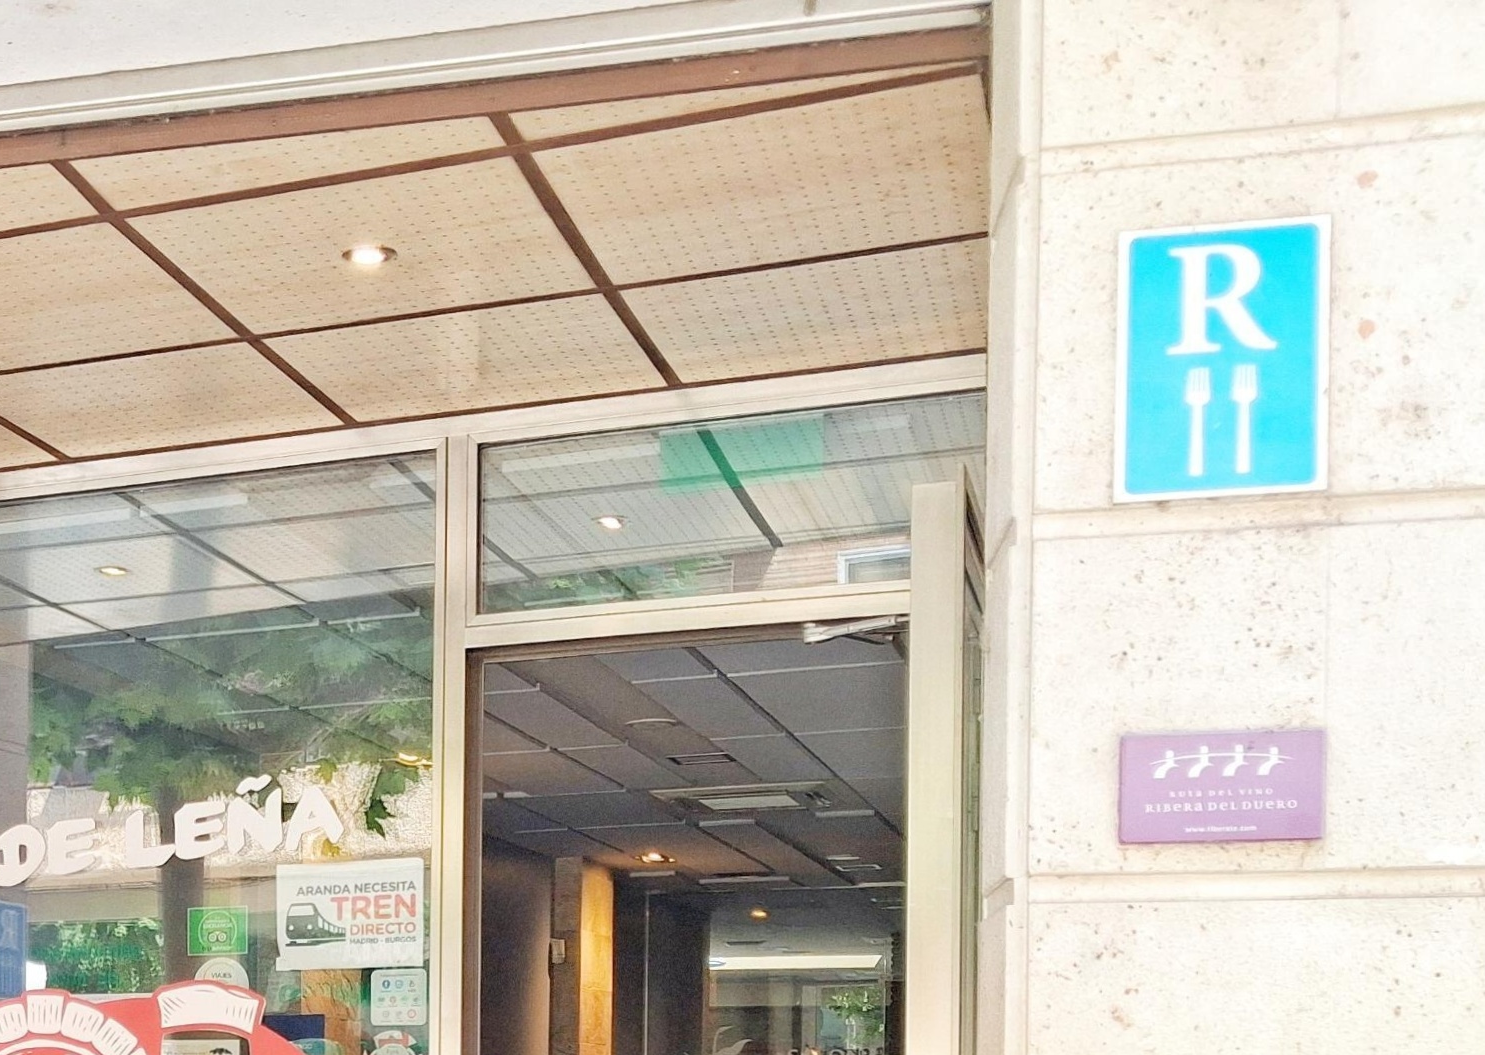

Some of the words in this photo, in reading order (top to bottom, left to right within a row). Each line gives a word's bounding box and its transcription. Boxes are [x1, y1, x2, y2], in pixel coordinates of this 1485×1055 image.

[1165, 243, 1278, 356] R
[123, 774, 344, 869] LEÑA
[296, 884, 351, 897] ARANDA
[354, 881, 417, 894] NECESITA
[330, 893, 417, 921] TREN
[349, 921, 417, 936] DIRECTO
[349, 937, 379, 945] MADRID
[384, 936, 417, 944] BURGOS
